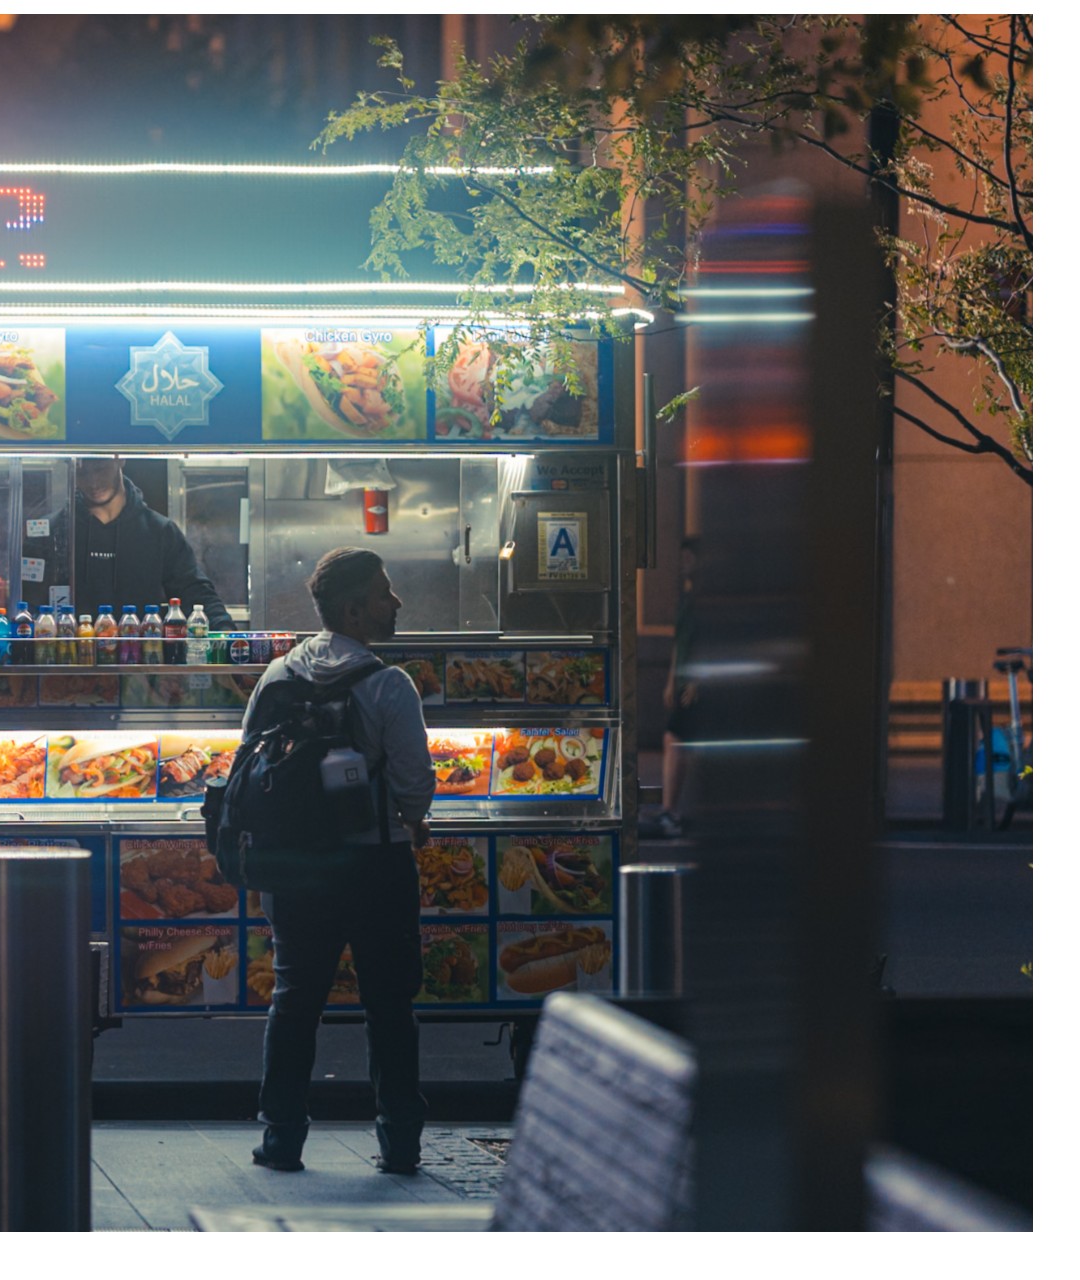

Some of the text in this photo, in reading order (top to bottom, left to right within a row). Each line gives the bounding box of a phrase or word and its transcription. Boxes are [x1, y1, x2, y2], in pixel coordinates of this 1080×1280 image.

[304, 328, 394, 346] Chicken Gyro
[141, 363, 200, 392] حلال
[150, 394, 191, 406] HALAL
[550, 527, 576, 557] A
[521, 727, 580, 737] Falafel Salad
[138, 927, 232, 939] Philly Cheese Steak
[138, 940, 172, 951] w/Fries
